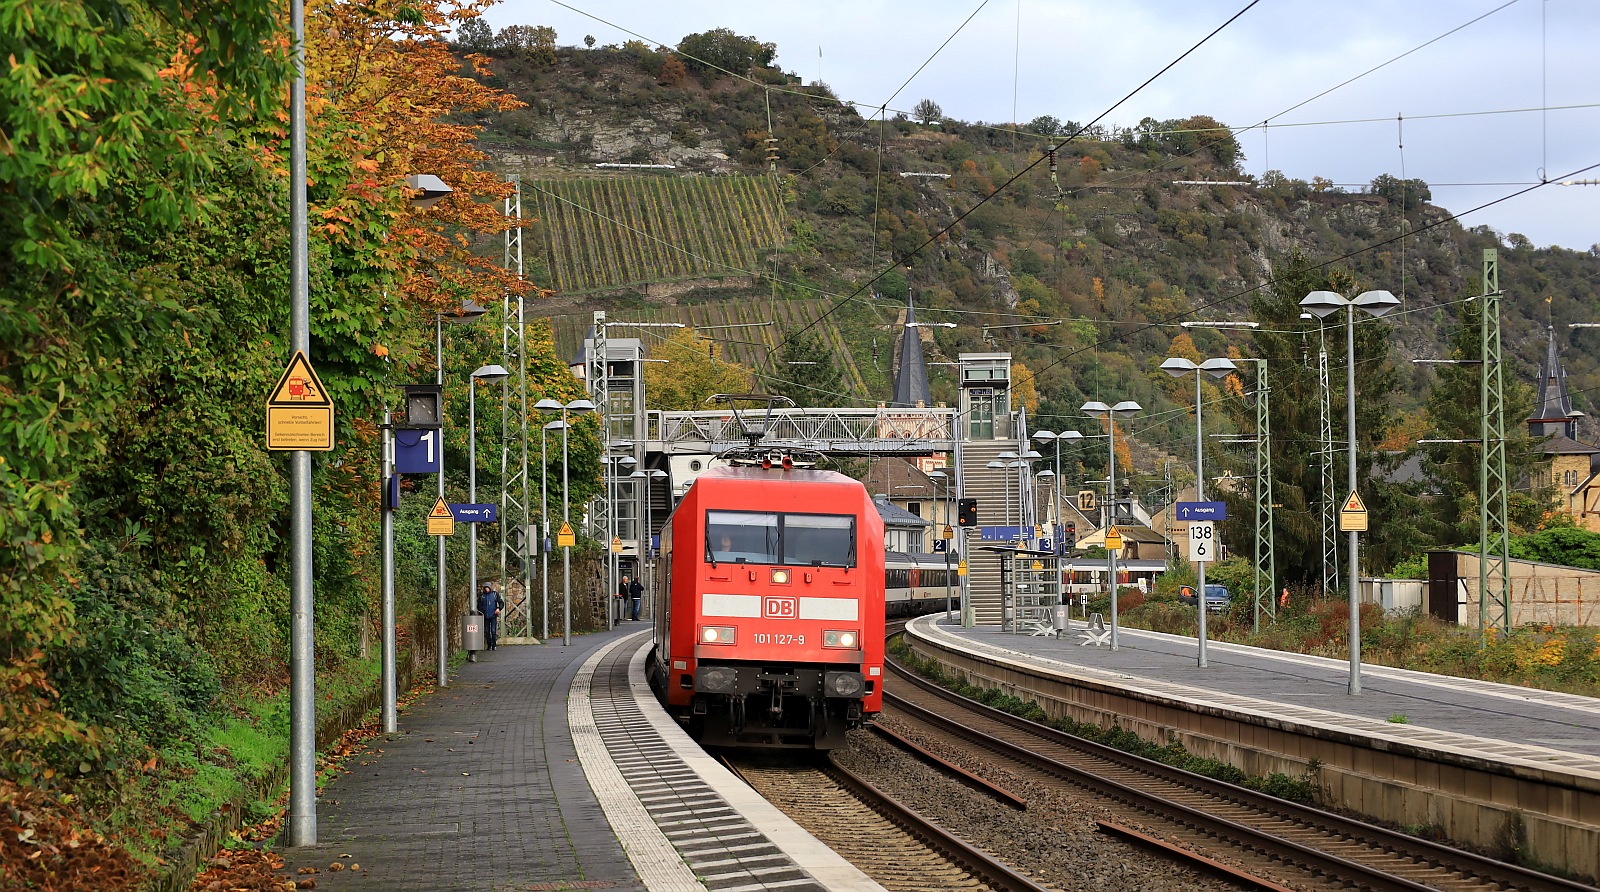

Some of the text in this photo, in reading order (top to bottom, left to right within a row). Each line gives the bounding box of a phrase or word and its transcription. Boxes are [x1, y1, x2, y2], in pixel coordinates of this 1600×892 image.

[421, 430, 434, 462] 1
[1080, 493, 1093, 508] 12
[1190, 526, 1212, 539] 138
[935, 540, 942, 550] 2
[1044, 539, 1051, 549] 3
[1197, 542, 1206, 556] 6
[1081, 595, 1087, 604] H
[768, 600, 792, 615] DB
[753, 633, 805, 645] 101 127-9
